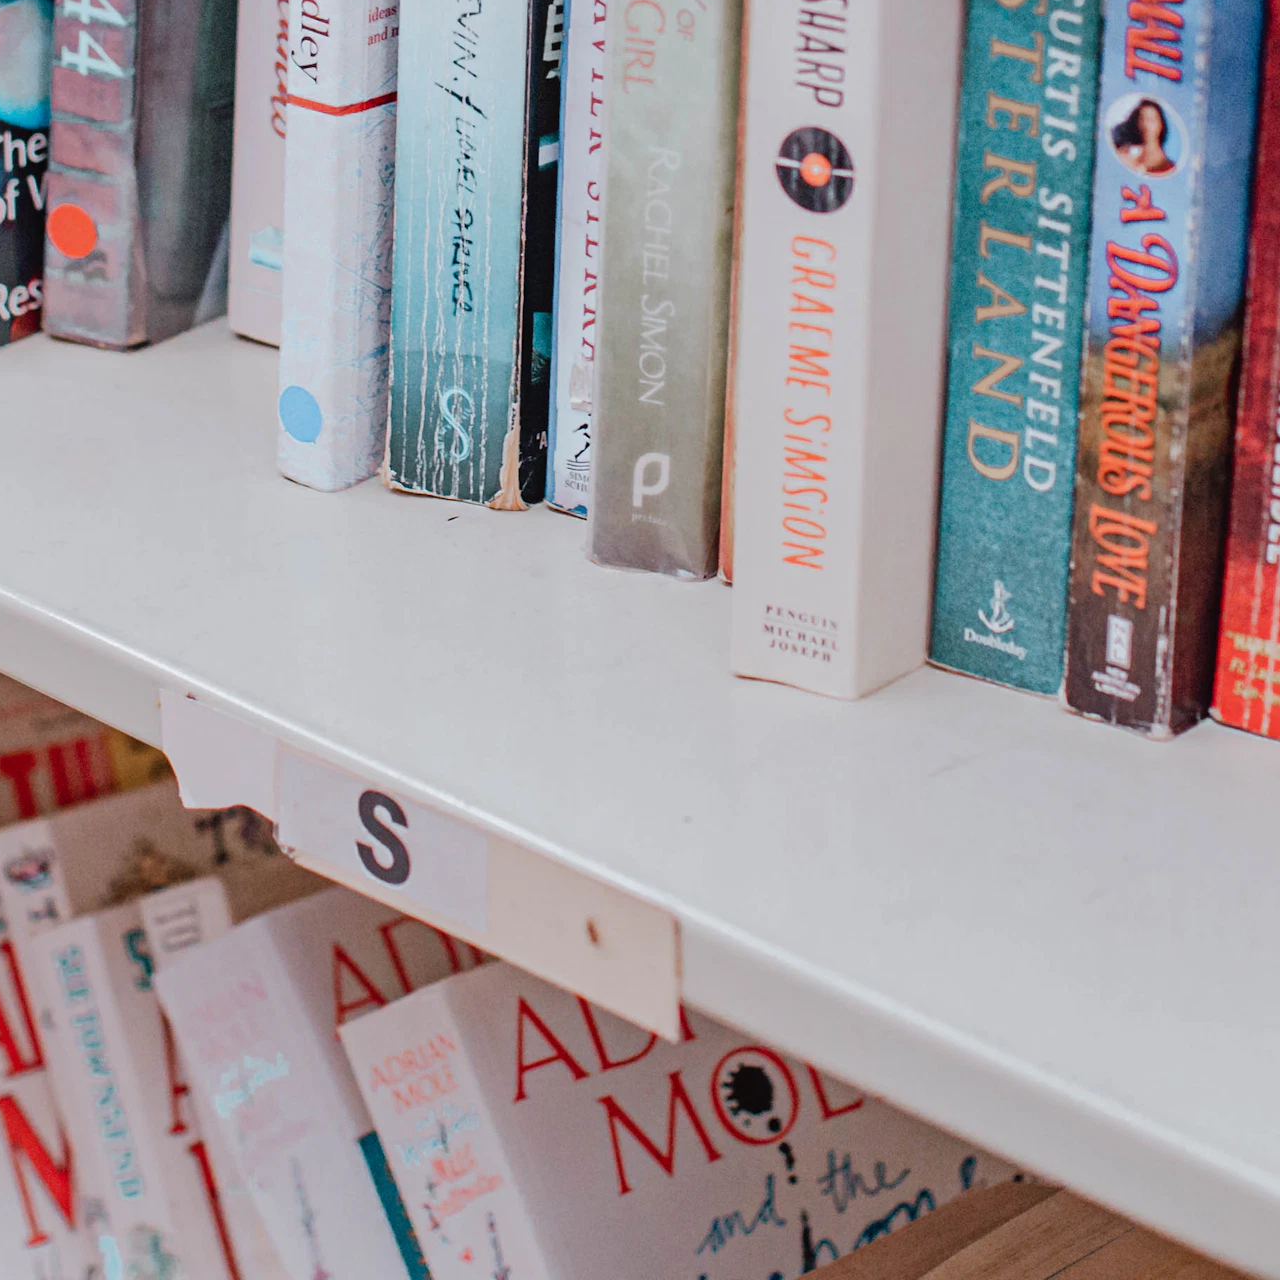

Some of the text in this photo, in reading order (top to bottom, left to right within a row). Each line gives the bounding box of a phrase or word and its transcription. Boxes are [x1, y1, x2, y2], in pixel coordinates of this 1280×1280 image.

[368, 4, 397, 23] ideas
[368, 30, 389, 45] and
[677, 9, 695, 42] OF
[1120, 184, 1167, 225] A
[637, 145, 681, 406] RACHEL SIMON
[786, 235, 837, 397] GRAEME
[1022, 186, 1073, 492] SITTENFELD
[1097, 232, 1179, 502] DANGEROUS
[782, 407, 831, 571] SIMSION
[1089, 502, 1158, 610] LOVE
[763, 622, 839, 651] MICHAEL
[765, 604, 838, 631] PENGUIN
[769, 639, 832, 663] JOSEPH
[355, 790, 411, 886] S
[817, 1149, 911, 1214] the
